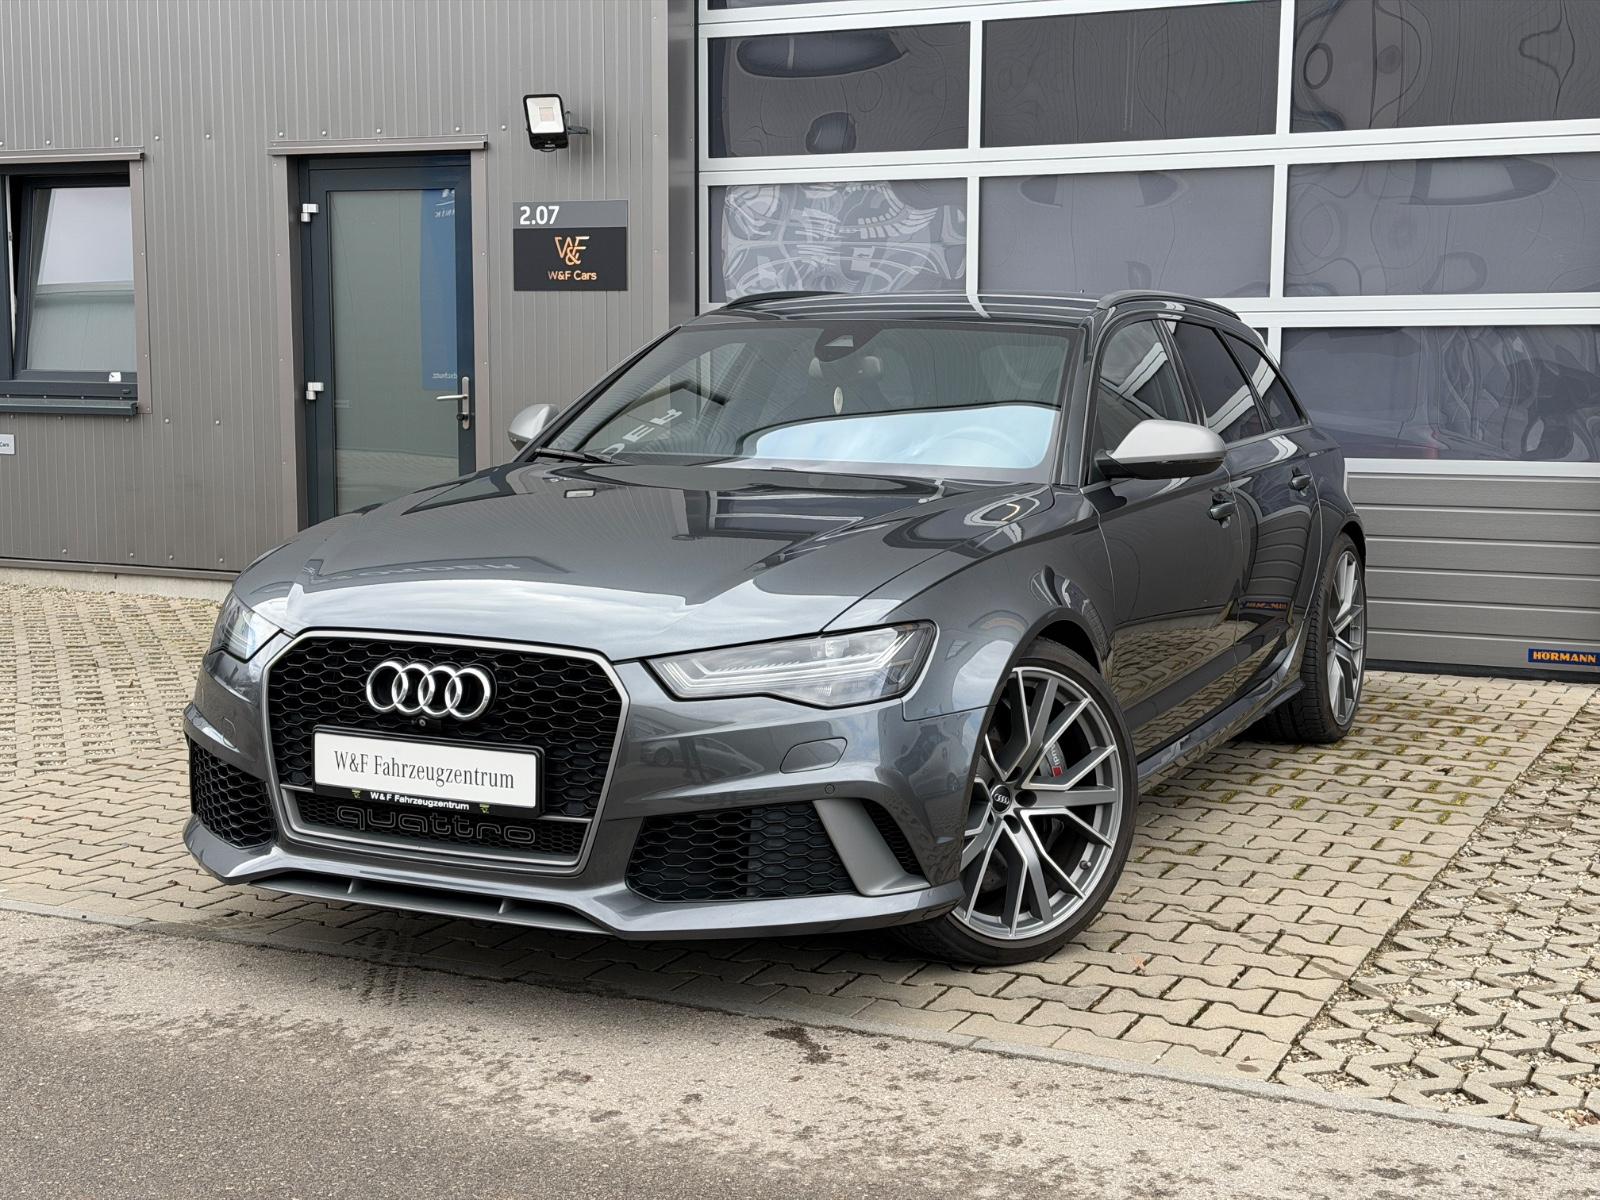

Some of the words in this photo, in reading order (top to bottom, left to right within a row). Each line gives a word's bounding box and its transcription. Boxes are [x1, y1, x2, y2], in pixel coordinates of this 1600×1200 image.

[520, 205, 560, 225] 2.07
[548, 270, 572, 281] W&F
[573, 270, 597, 281] Cars
[334, 750, 369, 774] W&F
[374, 755, 514, 788] Fahrzeugzentrum
[394, 794, 470, 811] Fahrzeugzentrum
[337, 805, 535, 844] quattro
